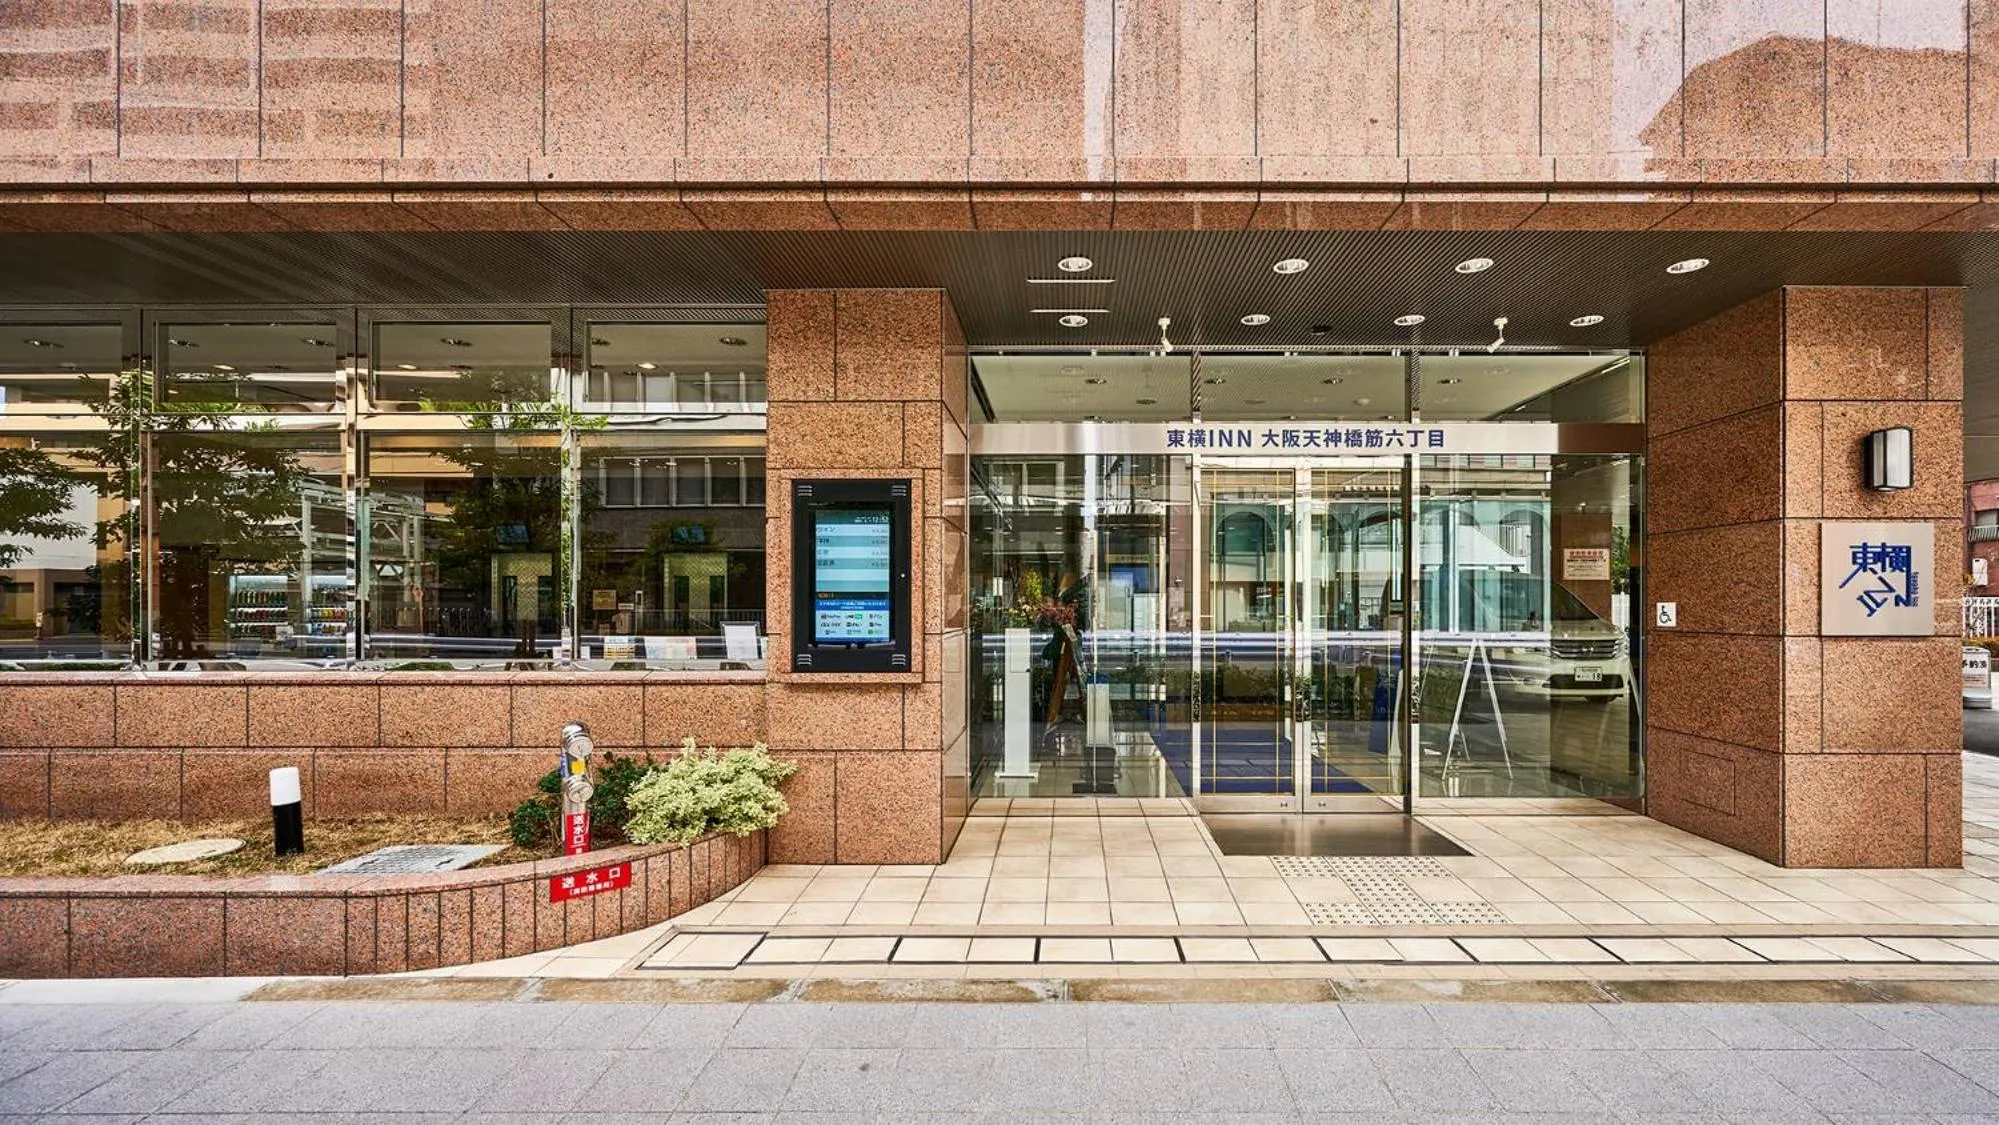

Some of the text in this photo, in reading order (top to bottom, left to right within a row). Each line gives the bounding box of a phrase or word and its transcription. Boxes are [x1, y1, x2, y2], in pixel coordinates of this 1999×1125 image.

[1166, 429, 1445, 447] 東横INN 大阪天神橋筋六丁目
